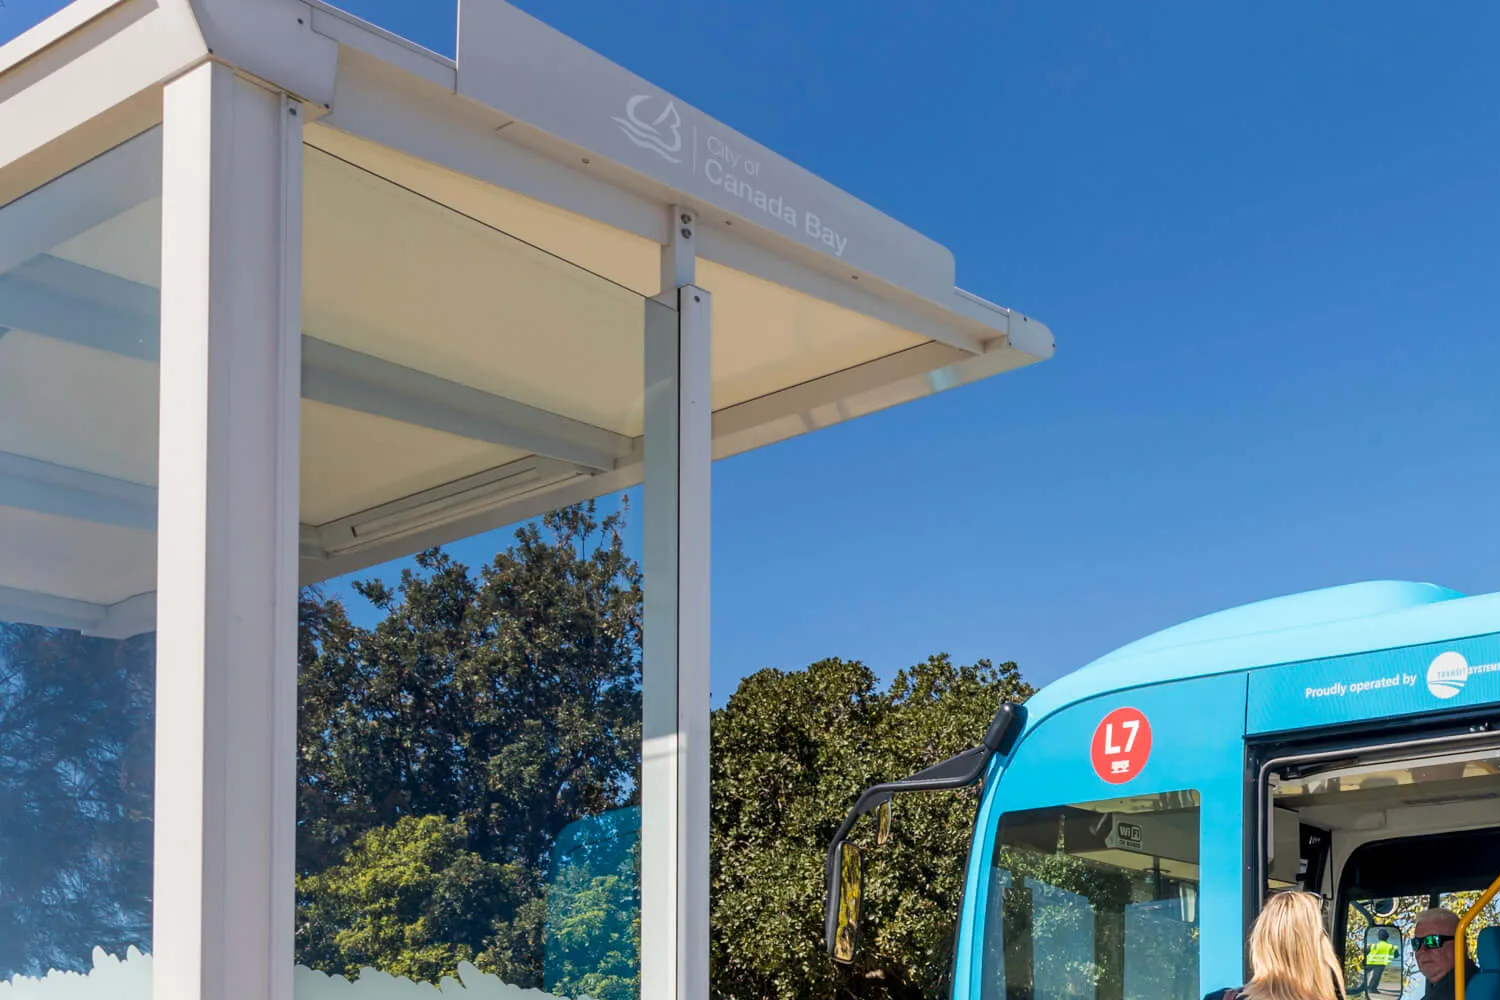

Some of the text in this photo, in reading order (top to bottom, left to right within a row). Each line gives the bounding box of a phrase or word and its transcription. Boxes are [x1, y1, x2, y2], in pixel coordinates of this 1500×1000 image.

[706, 135, 761, 178] City of
[704, 157, 849, 256] Canada Bay
[1304, 672, 1417, 699] Proudly operated by
[1104, 719, 1140, 755] L7
